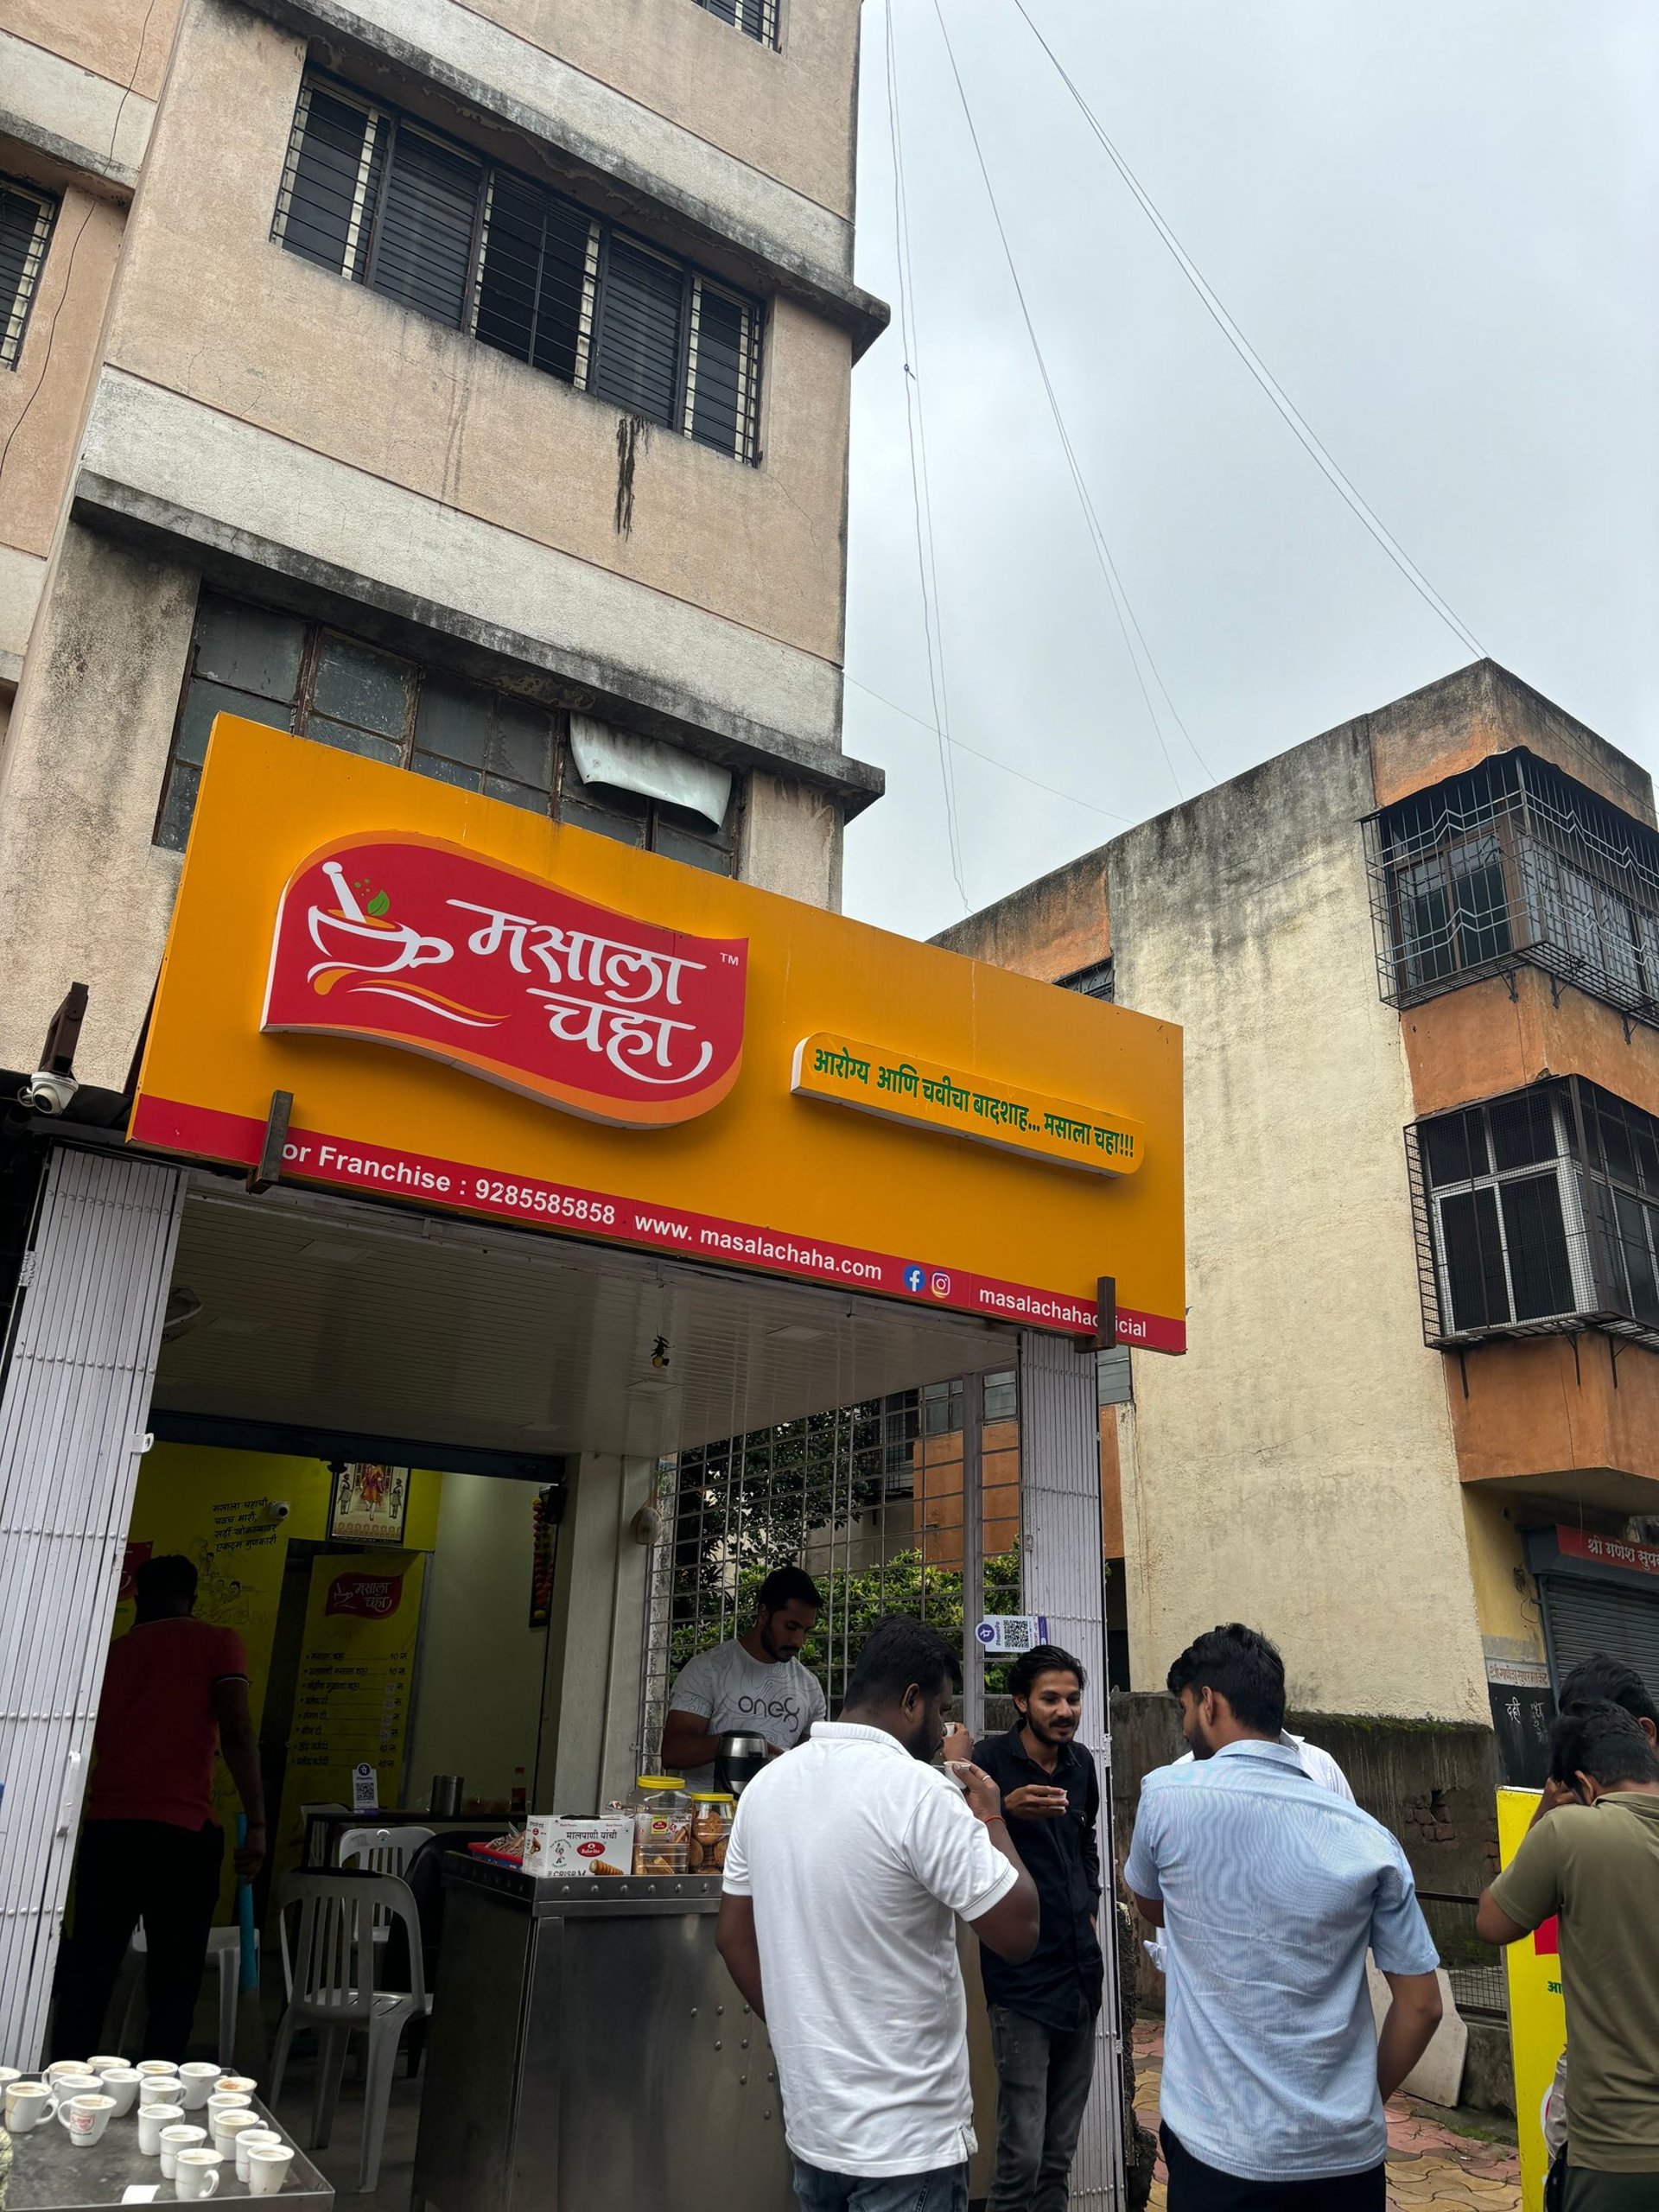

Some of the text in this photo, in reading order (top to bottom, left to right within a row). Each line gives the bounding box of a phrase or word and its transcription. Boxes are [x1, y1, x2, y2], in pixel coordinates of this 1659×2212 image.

[446, 899, 708, 1005] मसाला
[525, 988, 714, 1084] चहा
[814, 1046, 1135, 1159] आरोग्य आणि चवीचा बादशाह... मसाला चहा!!!
[282, 1143, 312, 1162] or
[318, 1145, 451, 1192] Franchise
[475, 1177, 615, 1225] 9285585858
[699, 1229, 882, 1281] masalachaha.com
[1587, 1535, 1604, 1554] श्री
[1605, 1541, 1636, 1562] गणेश
[353, 1582, 393, 1597] मसाला
[362, 1596, 393, 1613] चहा
[566, 1829, 599, 1840] मालपाणी
